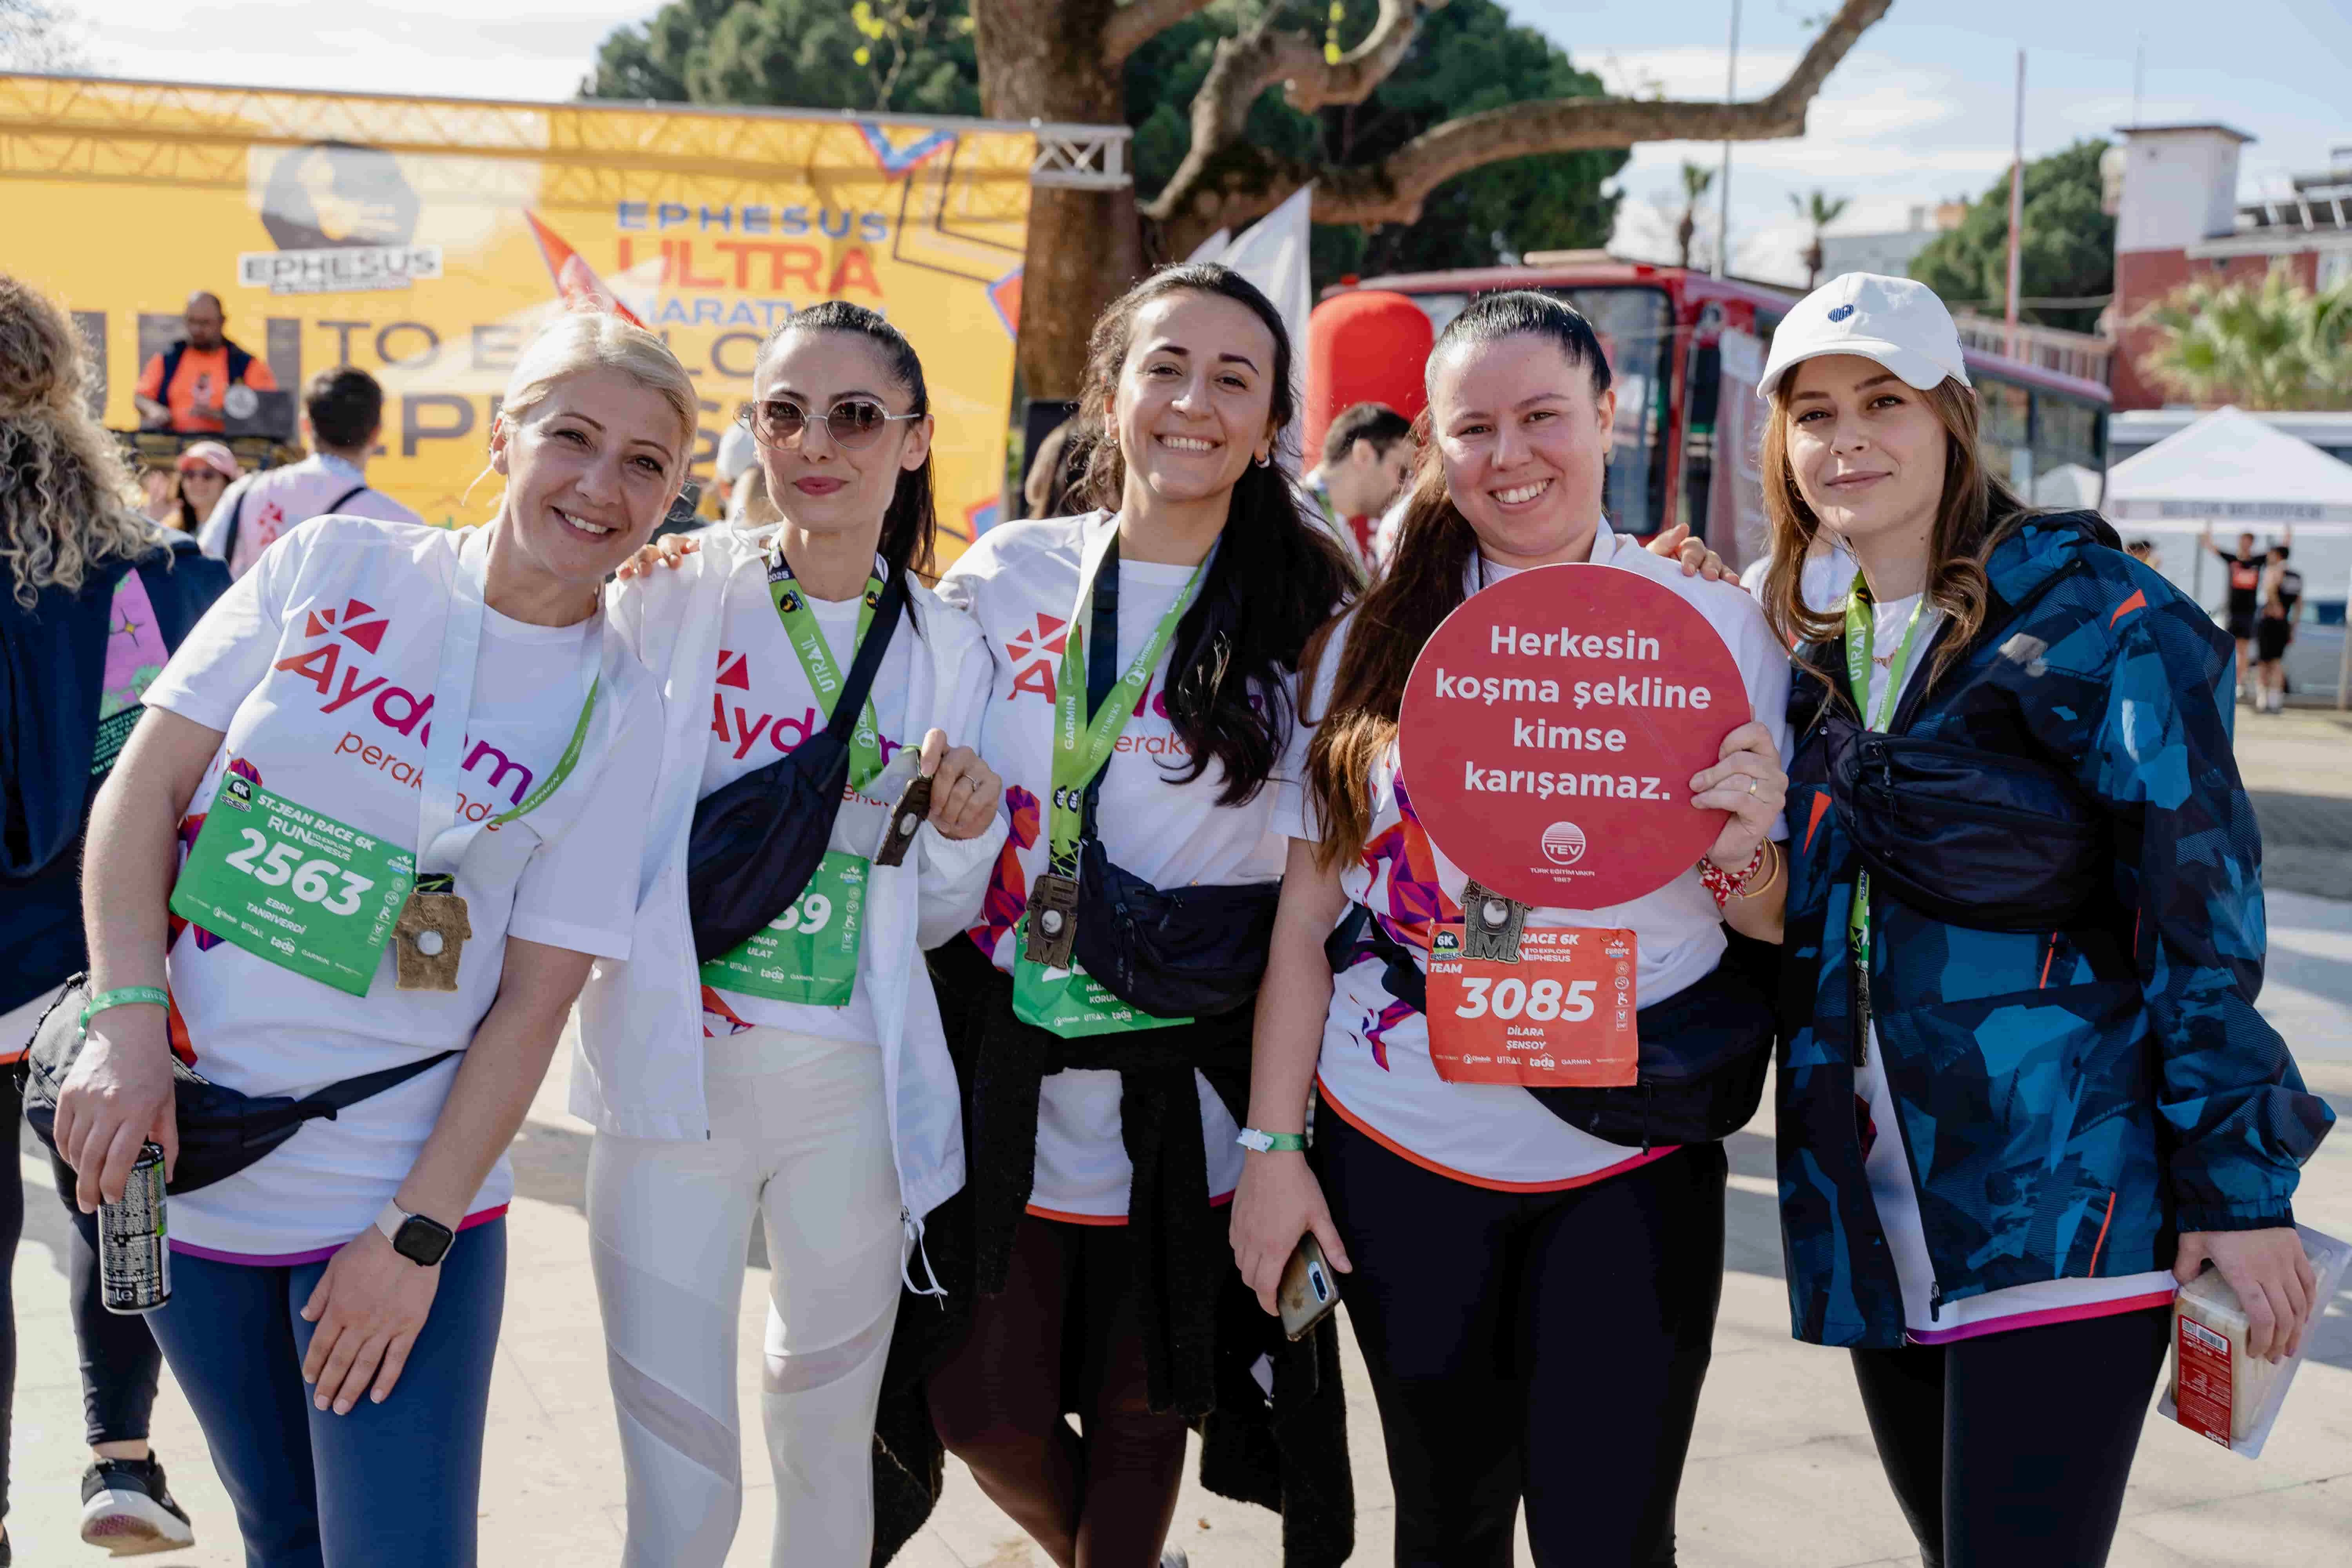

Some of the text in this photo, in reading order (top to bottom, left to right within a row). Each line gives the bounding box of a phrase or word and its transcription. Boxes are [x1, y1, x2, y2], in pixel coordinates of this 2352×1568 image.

[618, 201, 888, 242] EPHESUS
[245, 250, 436, 279] EPHESUS
[618, 238, 884, 298] ULTRA
[318, 320, 439, 369] TO
[1490, 626, 1659, 661] Herkesin
[800, 634, 836, 693] UTRAIL
[1436, 668, 1711, 710] koşma şekline
[1065, 694, 1076, 750] GARMIN
[1514, 718, 1626, 752] kimse
[232, 779, 249, 797] 6K
[1465, 761, 1671, 801] karışamaz.
[1070, 792, 1078, 808] 6K
[257, 794, 314, 825] ST.JEAN
[314, 818, 355, 842] RACE
[354, 836, 377, 851] 6K
[267, 815, 314, 844] RUN
[1546, 844, 1581, 855] TEV
[225, 827, 375, 916] 2563
[246, 902, 308, 935] TANRIVERDİ
[265, 897, 295, 915] EBRU
[768, 891, 832, 935] 59
[747, 946, 774, 959] ULAT
[1437, 935, 1454, 947] 6K
[1521, 933, 1580, 946] RACE 6K
[1430, 963, 1463, 974] TEAM
[1455, 977, 1598, 1022] 3085
[1506, 1040, 1547, 1051] ŞENSOY
[1507, 1024, 1544, 1036] DİLARA
[1530, 1057, 1555, 1067] tada
